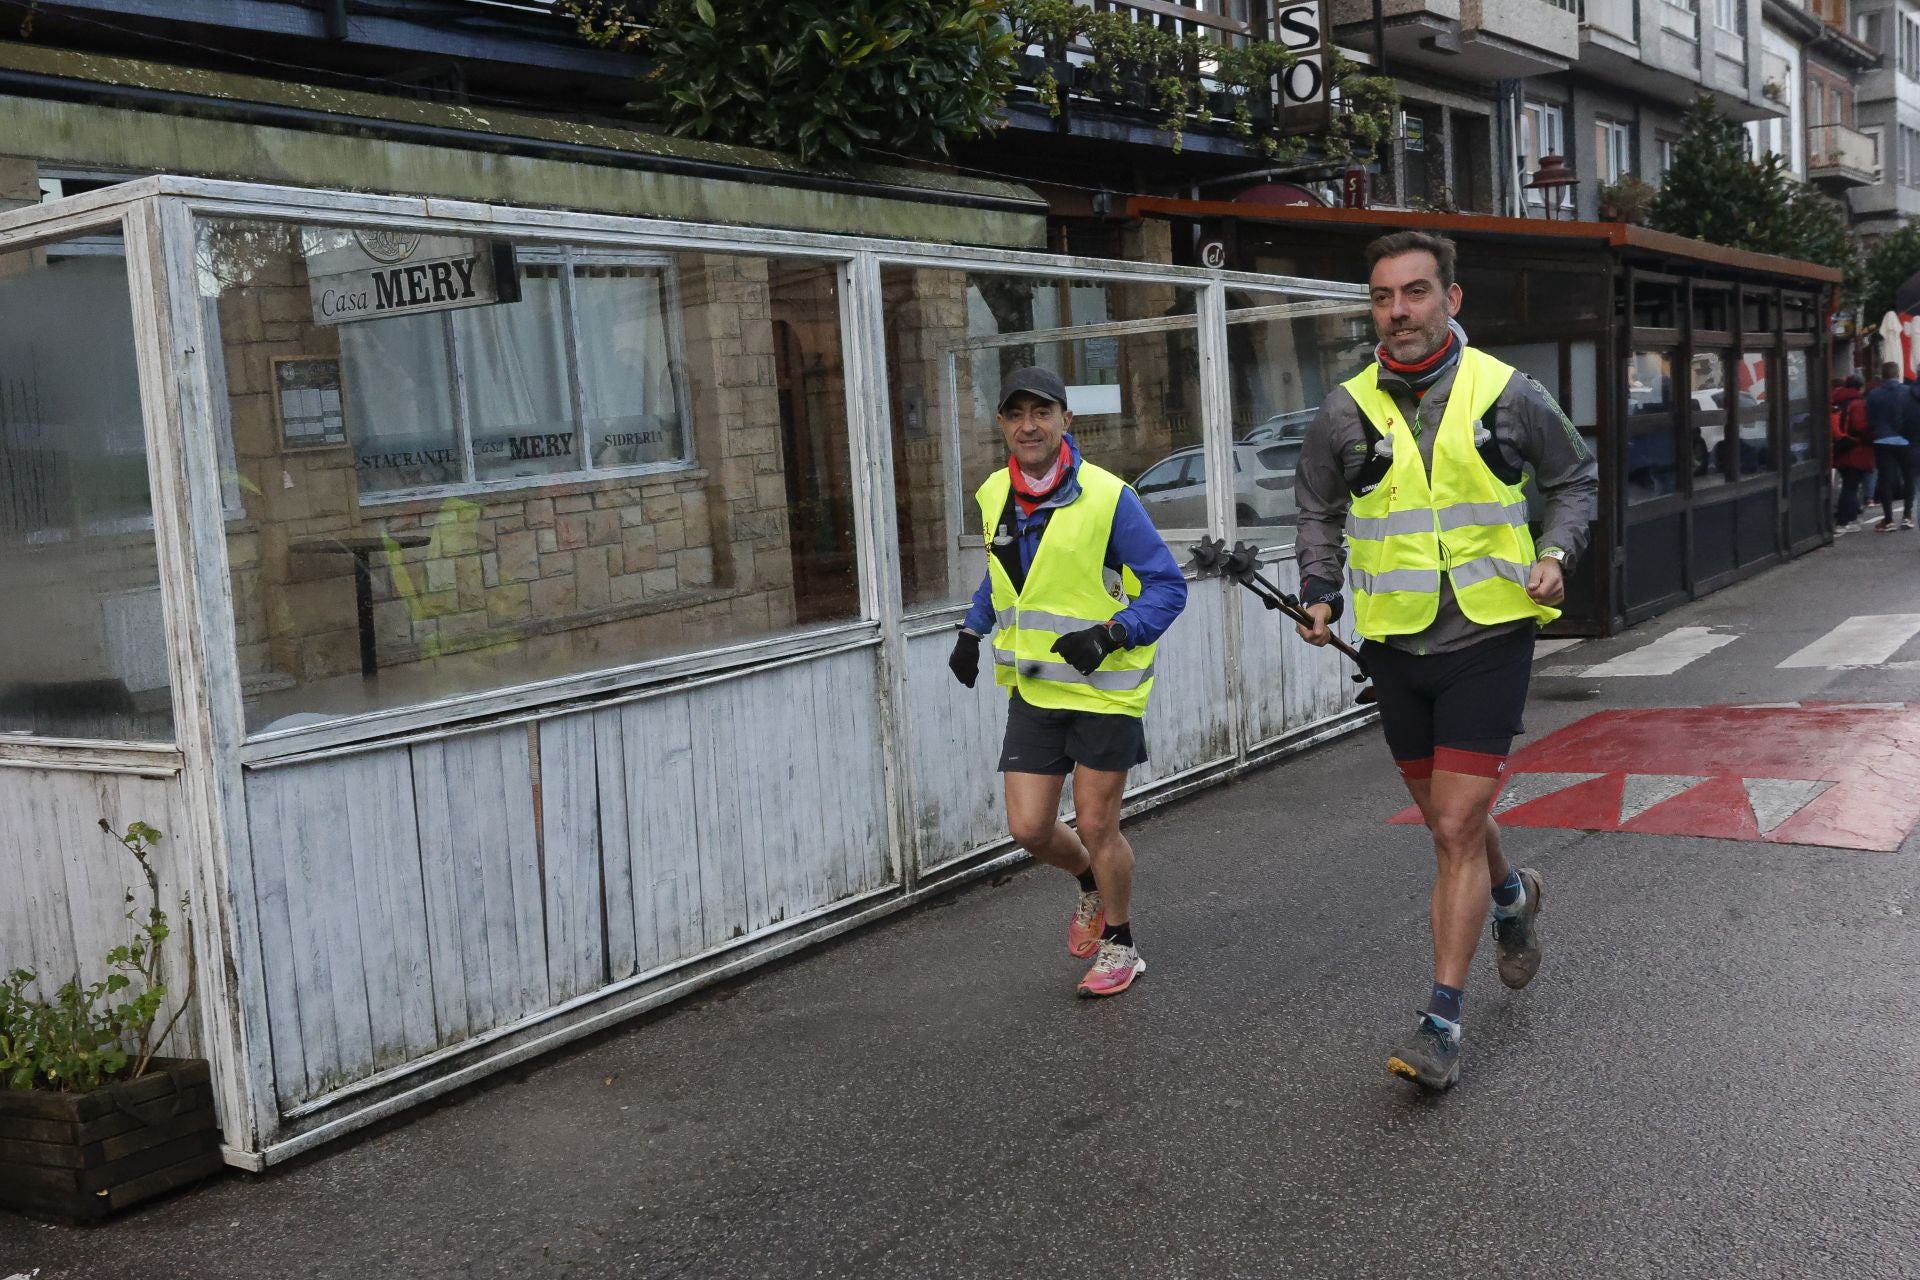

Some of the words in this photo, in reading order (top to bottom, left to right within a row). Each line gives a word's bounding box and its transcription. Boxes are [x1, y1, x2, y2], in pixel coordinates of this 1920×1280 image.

[321, 289, 369, 317] Casa
[371, 256, 479, 310] MERY
[509, 432, 573, 461] MERY
